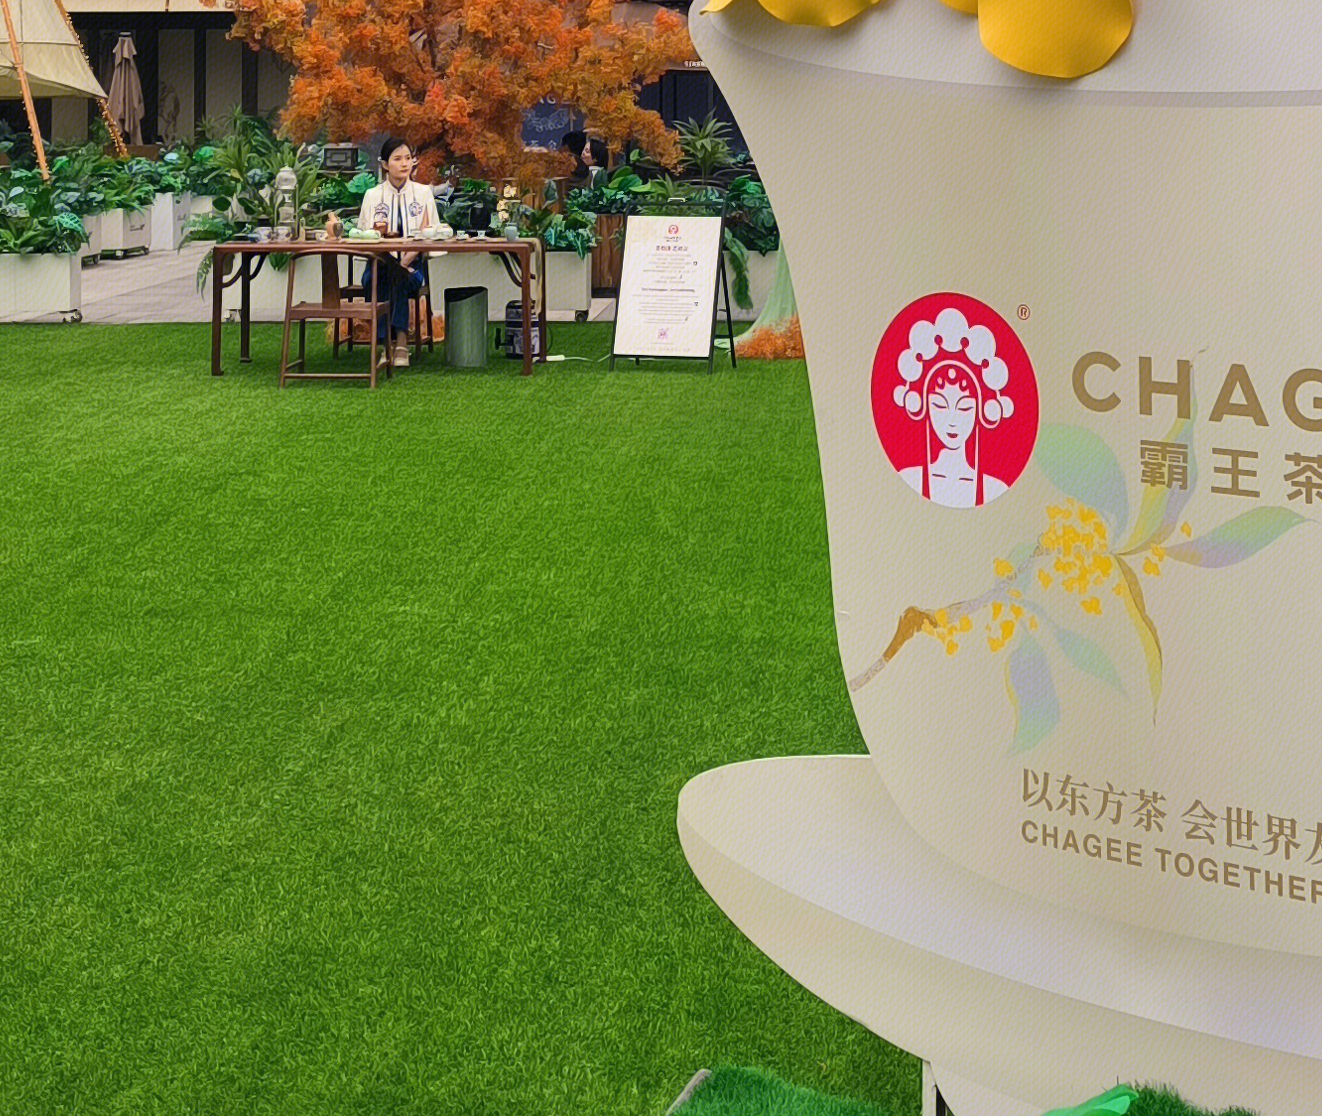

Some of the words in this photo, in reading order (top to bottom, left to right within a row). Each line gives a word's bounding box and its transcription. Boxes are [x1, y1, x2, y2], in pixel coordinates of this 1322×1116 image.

[1021, 768, 1168, 833] 以东方茶
[1021, 820, 1144, 868] CHAGEE
